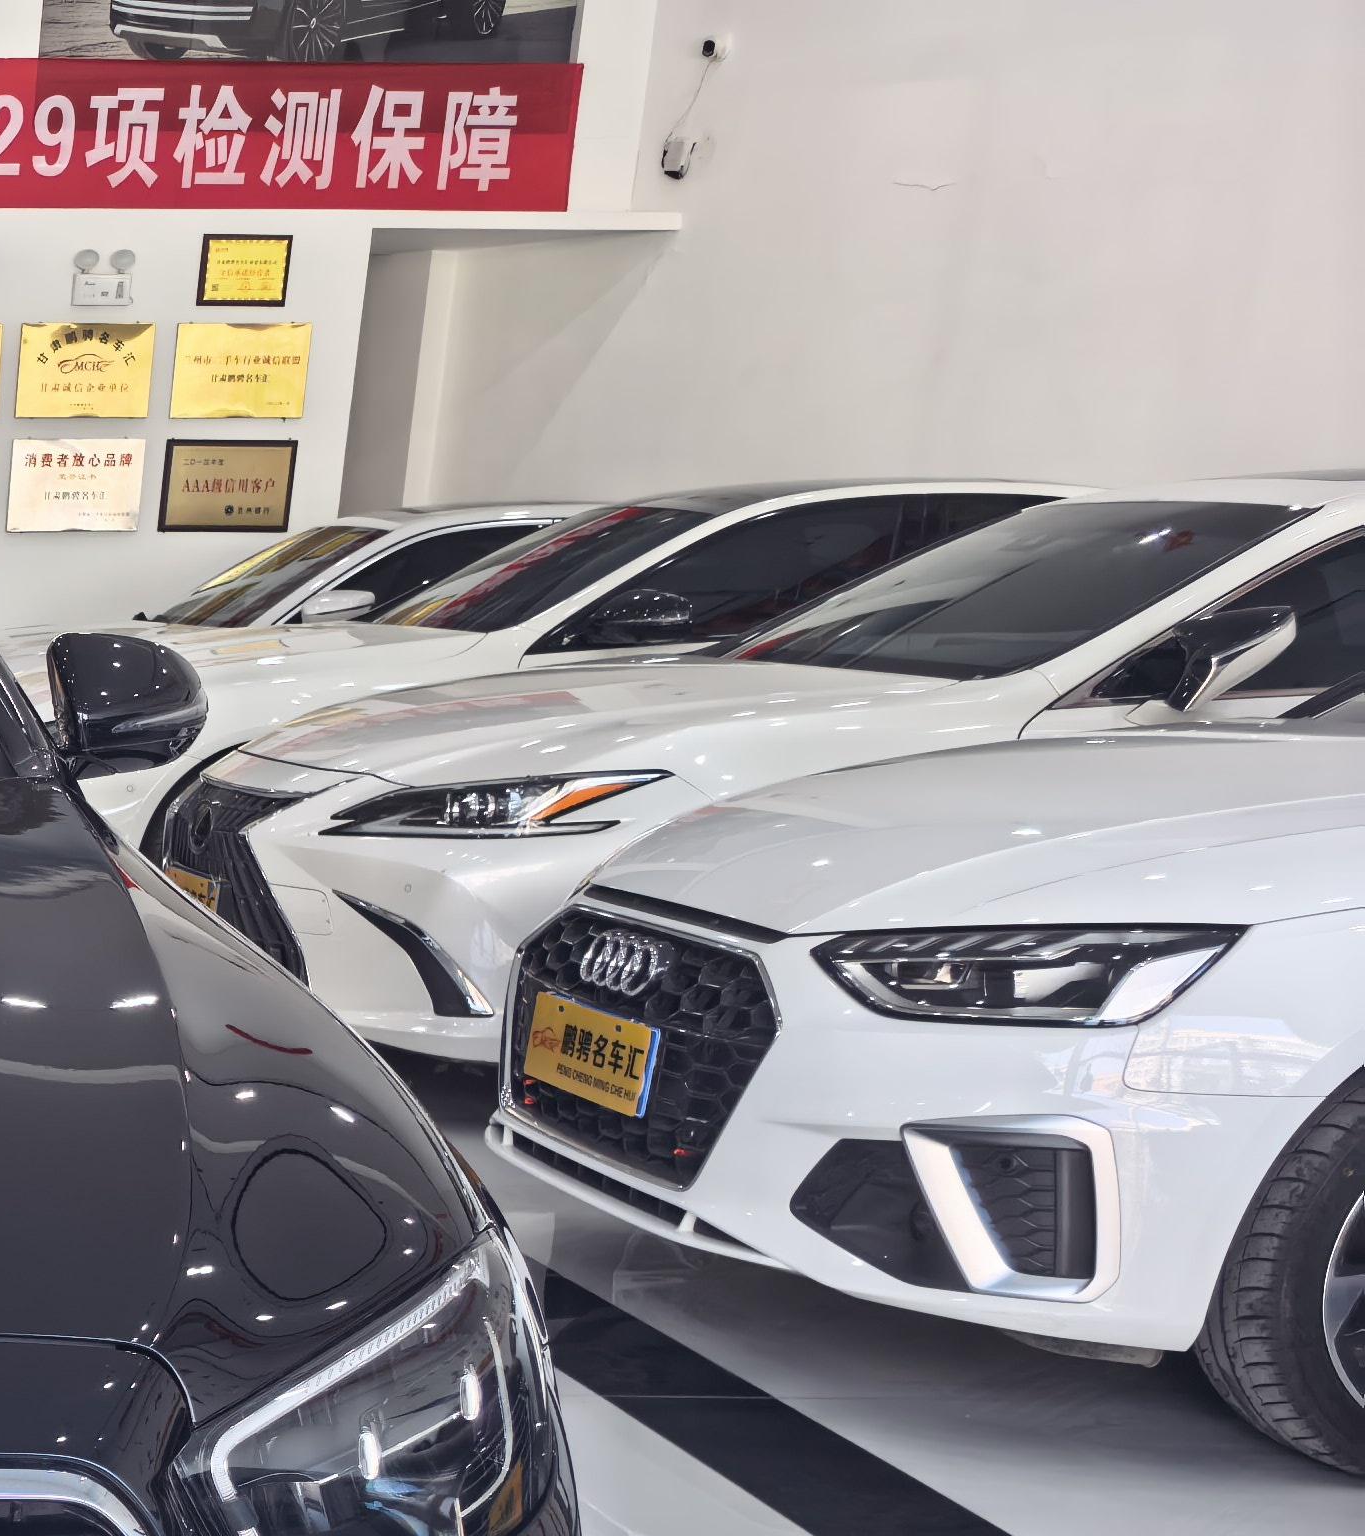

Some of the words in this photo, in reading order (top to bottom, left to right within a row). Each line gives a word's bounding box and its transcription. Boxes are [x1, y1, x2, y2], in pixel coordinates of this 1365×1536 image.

[24, 452, 133, 468] 消费者放心品牌
[561, 1023, 645, 1081] 鹏骋名车汇
